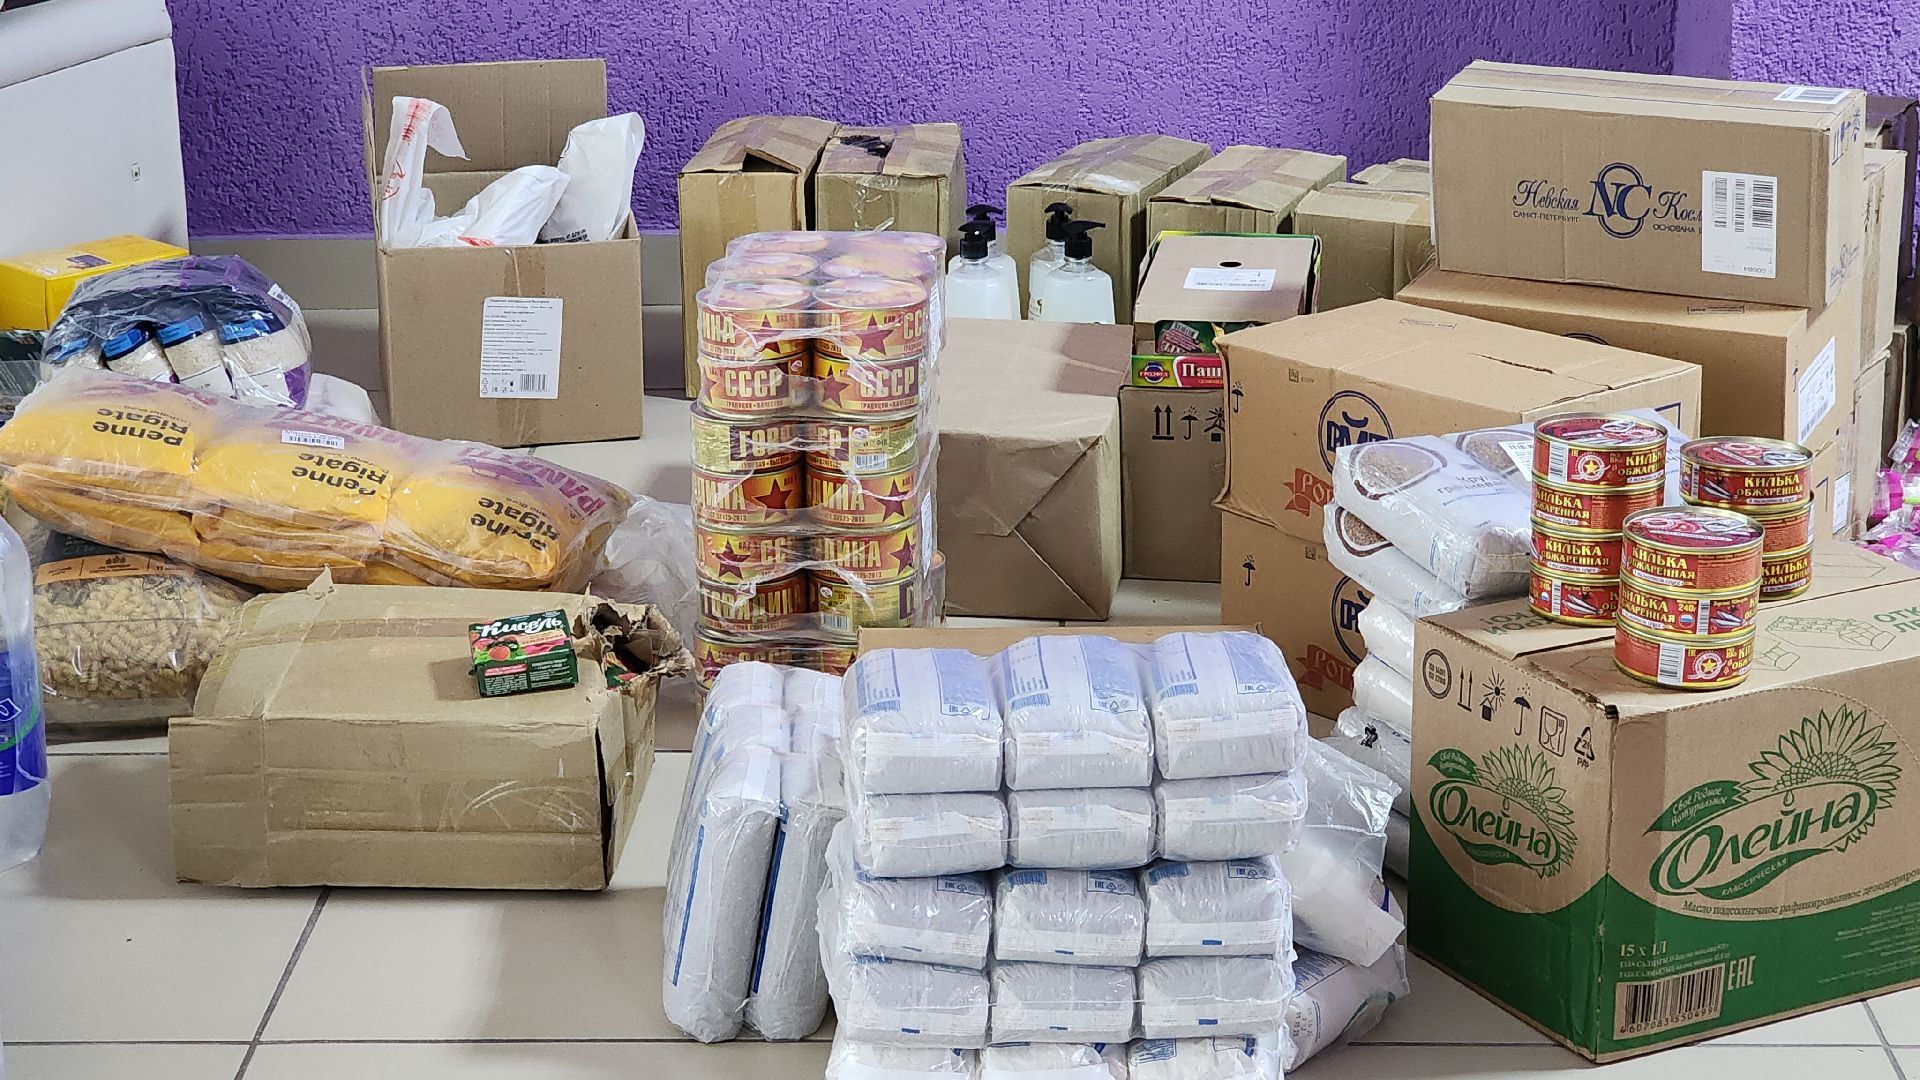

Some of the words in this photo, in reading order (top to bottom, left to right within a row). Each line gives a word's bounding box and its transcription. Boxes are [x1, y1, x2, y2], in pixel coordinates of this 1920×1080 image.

[1512, 180, 1580, 209] Невская
[1513, 211, 1580, 223] САНКТ-ПЕТЕРБУРГ
[1653, 224, 1696, 233] ОСНОВАНА
[703, 310, 737, 343] ИНА
[903, 309, 923, 339] СС
[725, 369, 783, 397] СССР
[861, 366, 915, 398] СССР
[1182, 363, 1222, 377] Паш
[93, 421, 183, 446] Penne
[96, 408, 188, 434] Rigate
[291, 466, 377, 496] Penne
[298, 453, 390, 485] Rigate
[1745, 474, 1800, 487] КИЛЬКА
[1737, 484, 1803, 497] ОБЖАРЕННАЯ
[1535, 502, 1590, 519] БЖАРЕННАЯ
[761, 537, 787, 566] СС
[823, 539, 881, 569] ДИНА
[1541, 551, 1610, 566] ОБЖАРЕННАЯ
[1545, 540, 1602, 557] КИЛЬКА
[1632, 547, 1688, 570] КИЛЬКА
[1761, 558, 1808, 576] КИЛЬКА
[1622, 588, 1669, 613] КИЛЬКА
[475, 617, 563, 637] Кисель
[1438, 786, 1551, 858] Олейна
[1671, 795, 1728, 827] Натуральное
[1667, 791, 1862, 889] Олейна
[1720, 857, 1789, 897] КЛАССИЧЕСКАЯ
[1682, 900, 1712, 914] Масло
[1713, 905, 1778, 917] подсолнечное
[1620, 943, 1635, 957] 15
[1728, 955, 1757, 991] EAC
